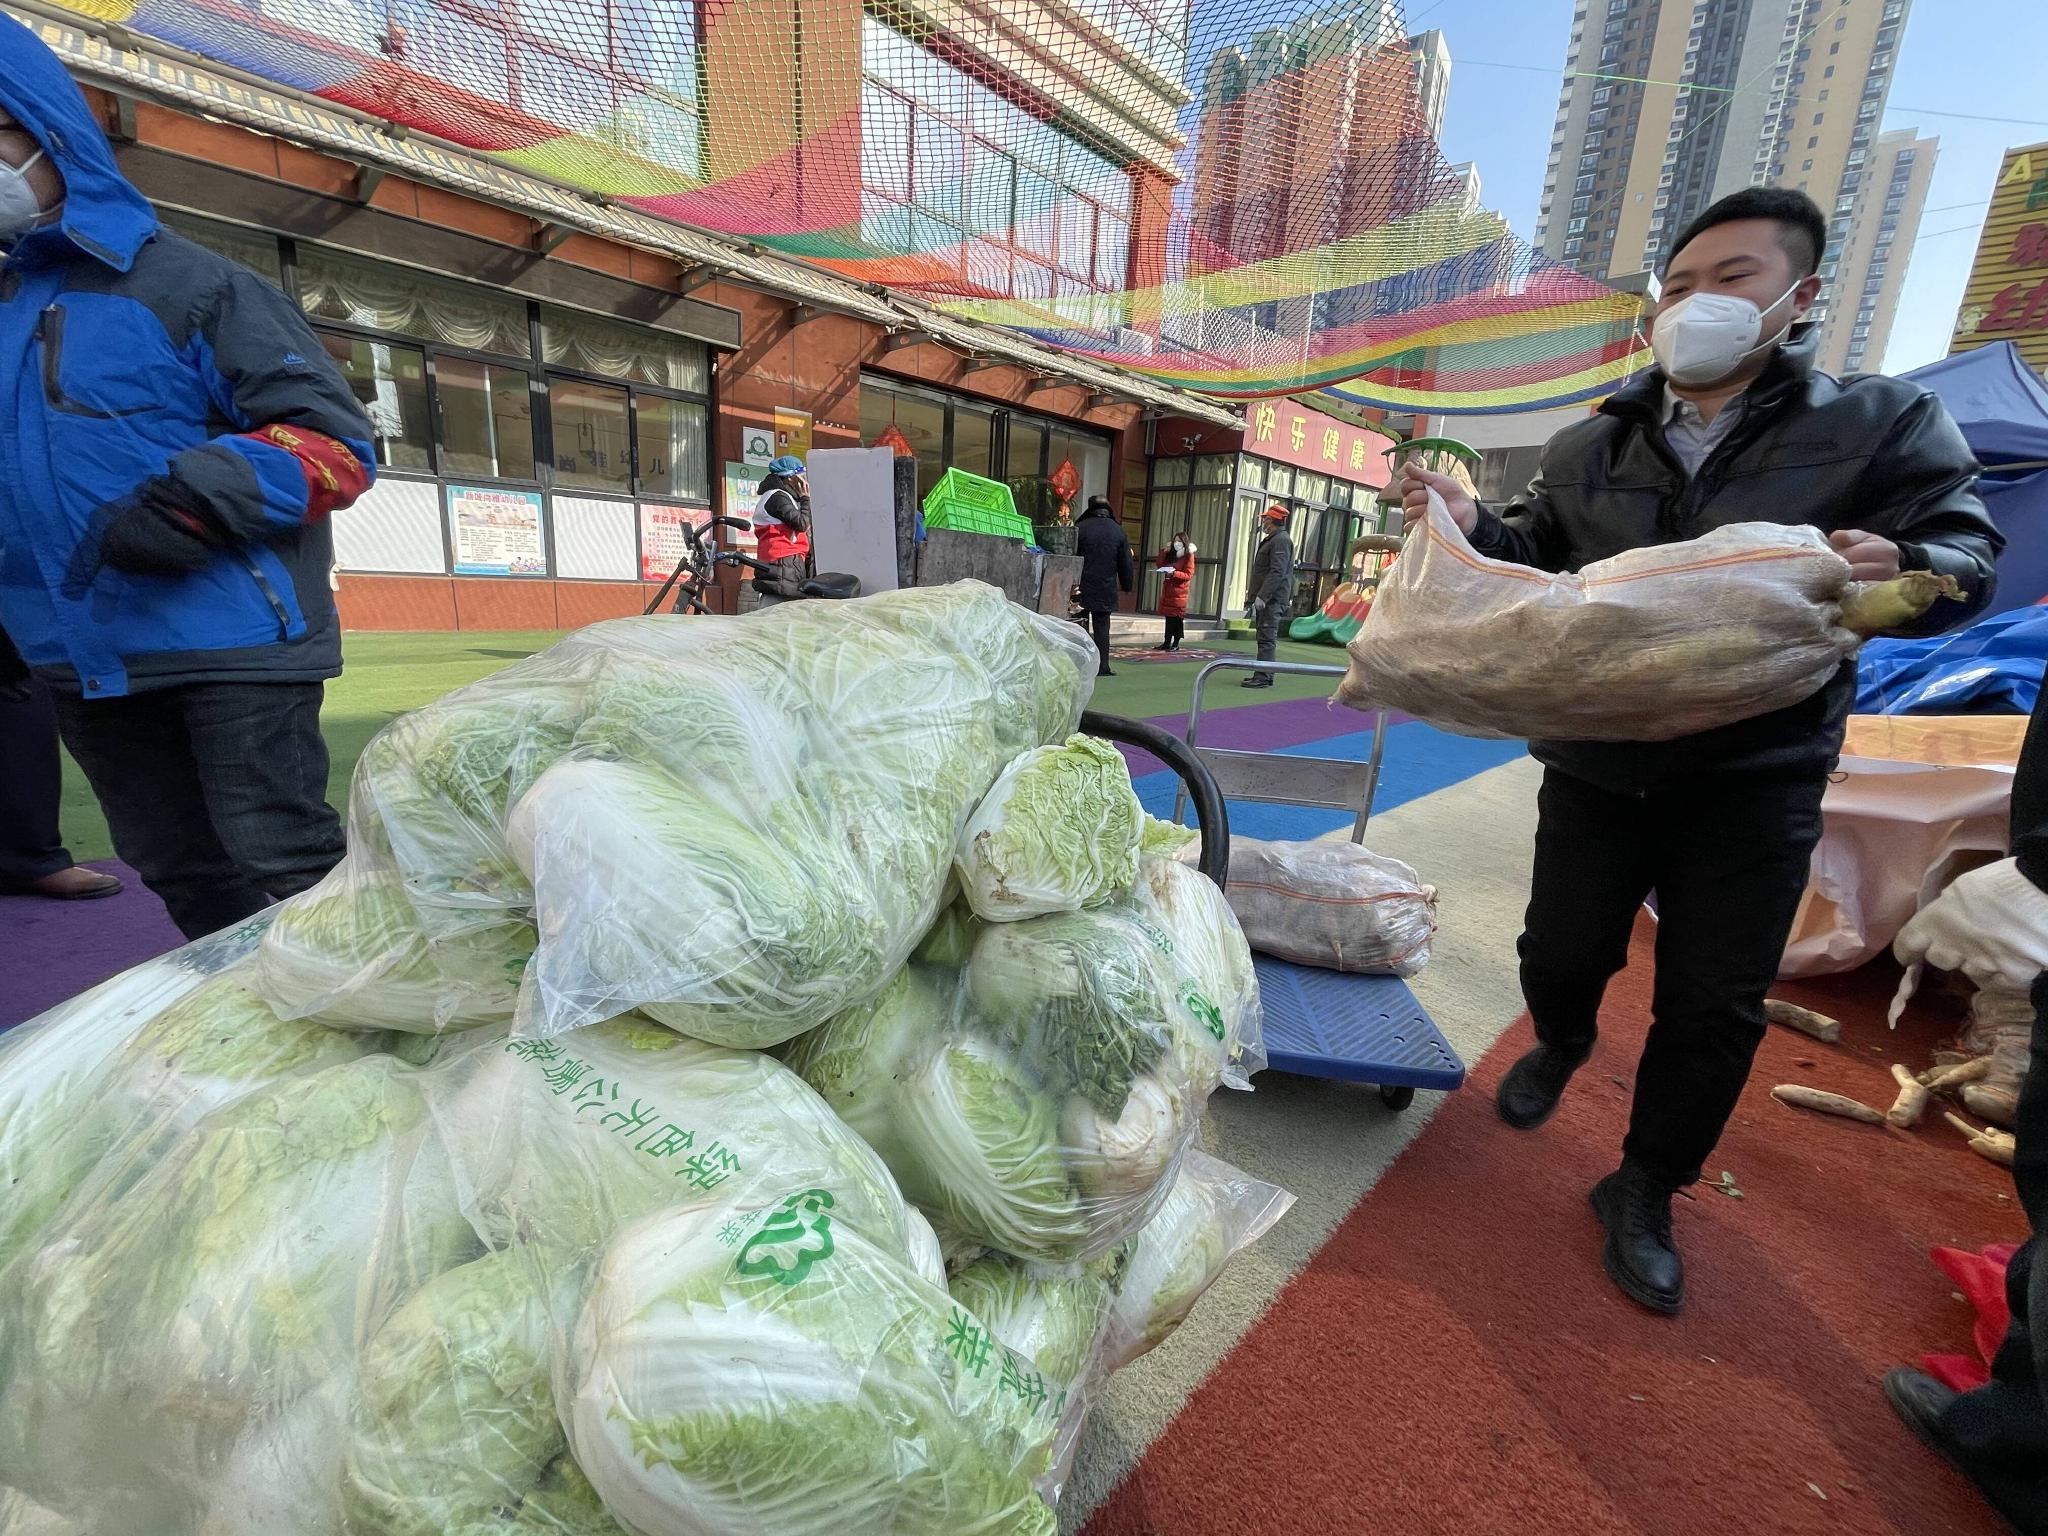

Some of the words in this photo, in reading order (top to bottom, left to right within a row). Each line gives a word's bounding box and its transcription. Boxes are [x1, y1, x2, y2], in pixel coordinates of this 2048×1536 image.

[1255, 401, 1365, 471] 快乐健康
[494, 1036, 742, 1190] 绿色无公害蔬
